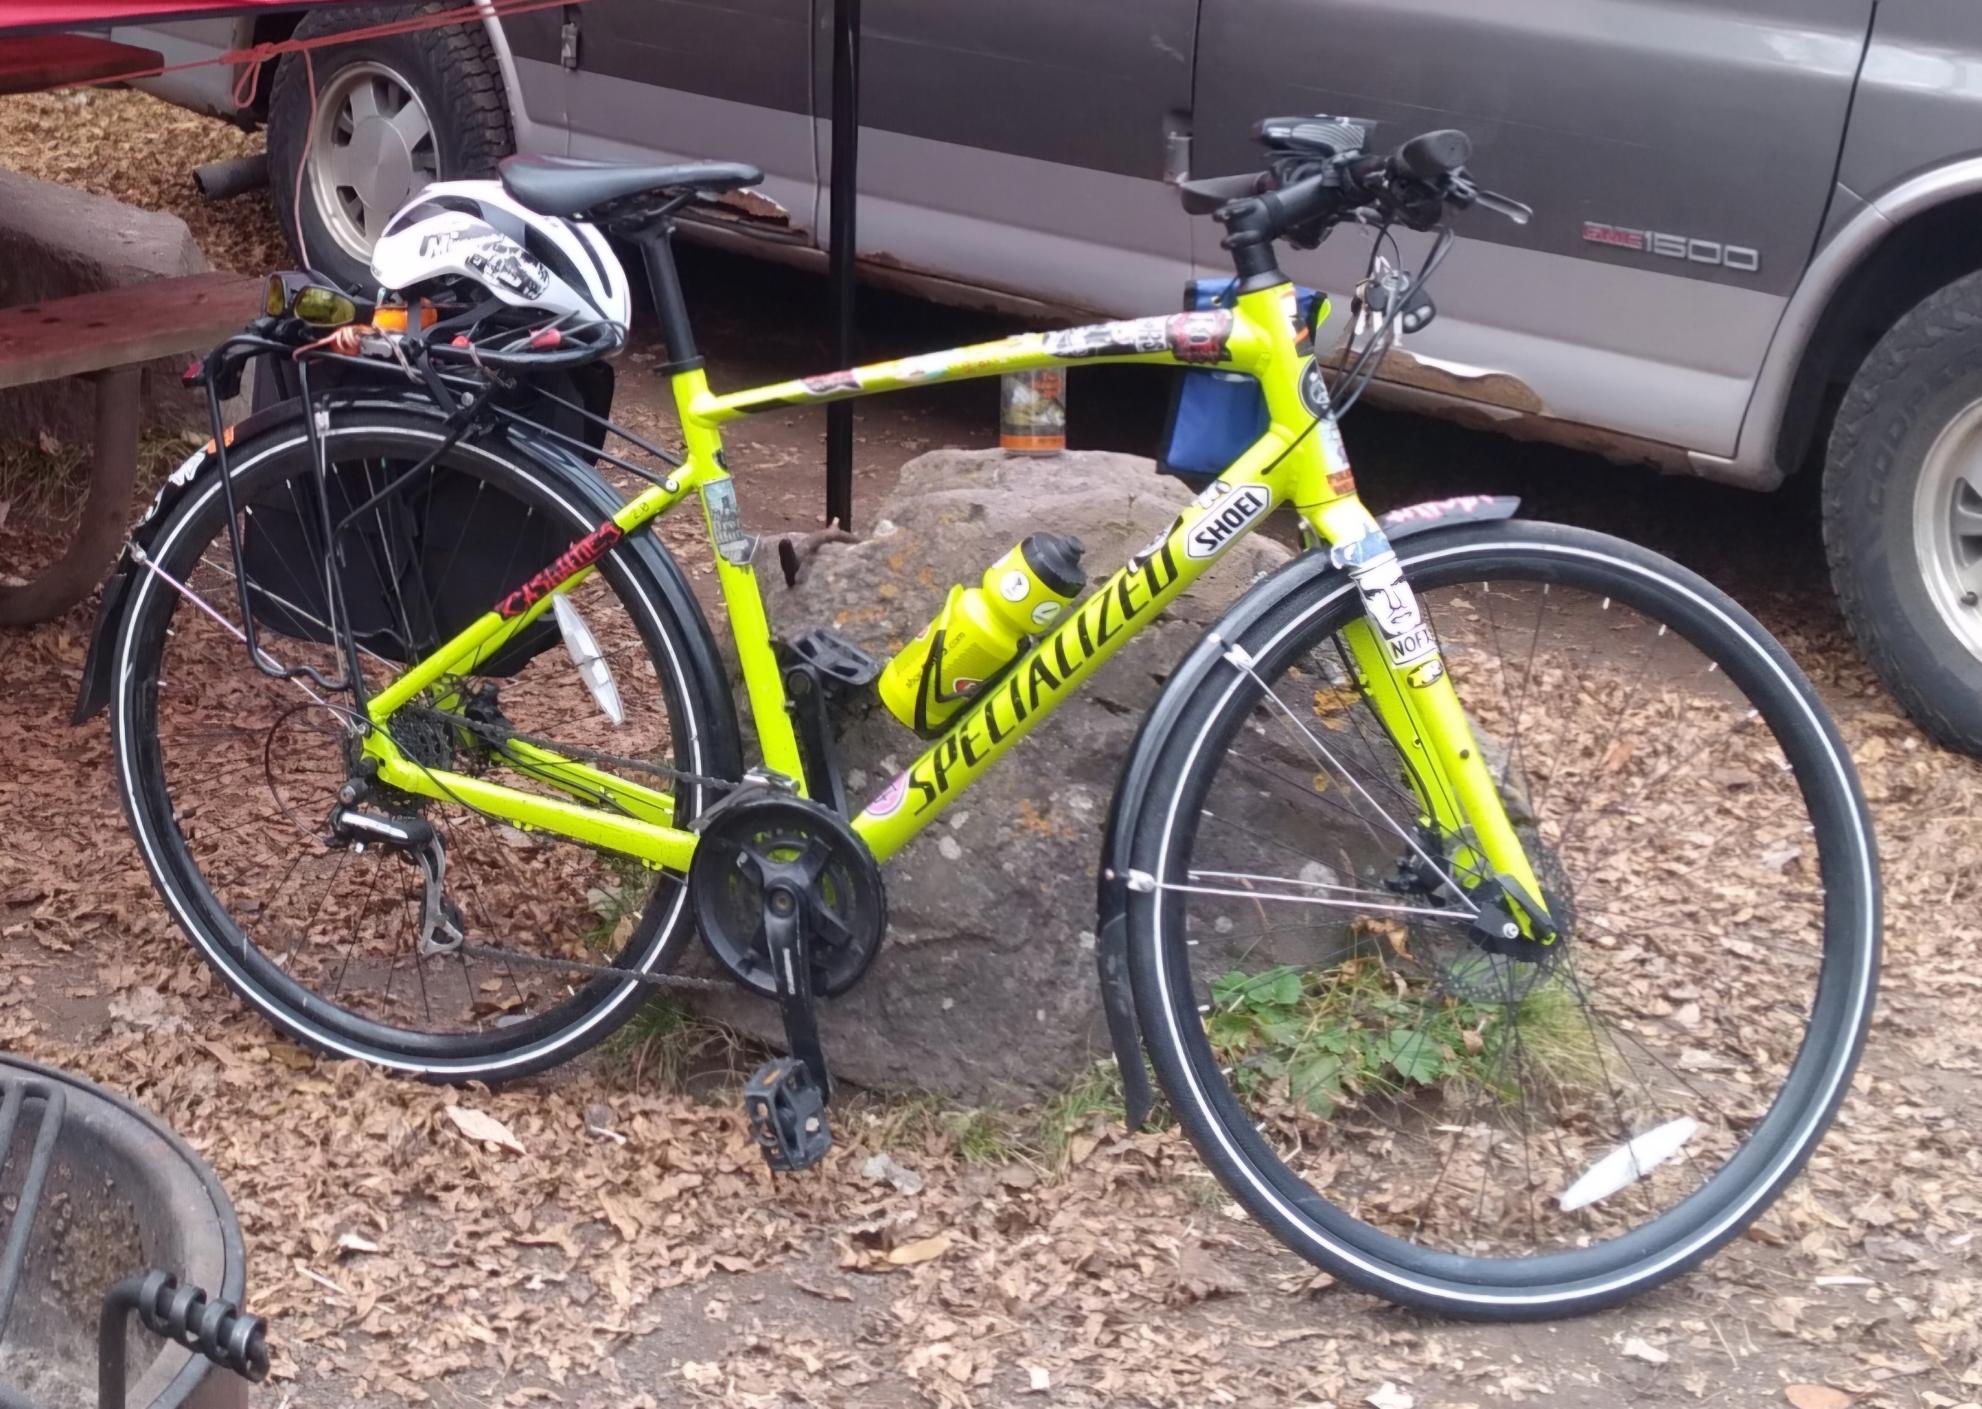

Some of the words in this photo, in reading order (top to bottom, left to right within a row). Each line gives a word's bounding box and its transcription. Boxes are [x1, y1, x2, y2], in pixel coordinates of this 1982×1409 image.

[1645, 230, 1759, 271] 1500
[1195, 491, 1264, 551] SHOEI
[908, 515, 1184, 817] SPECIALIZED
